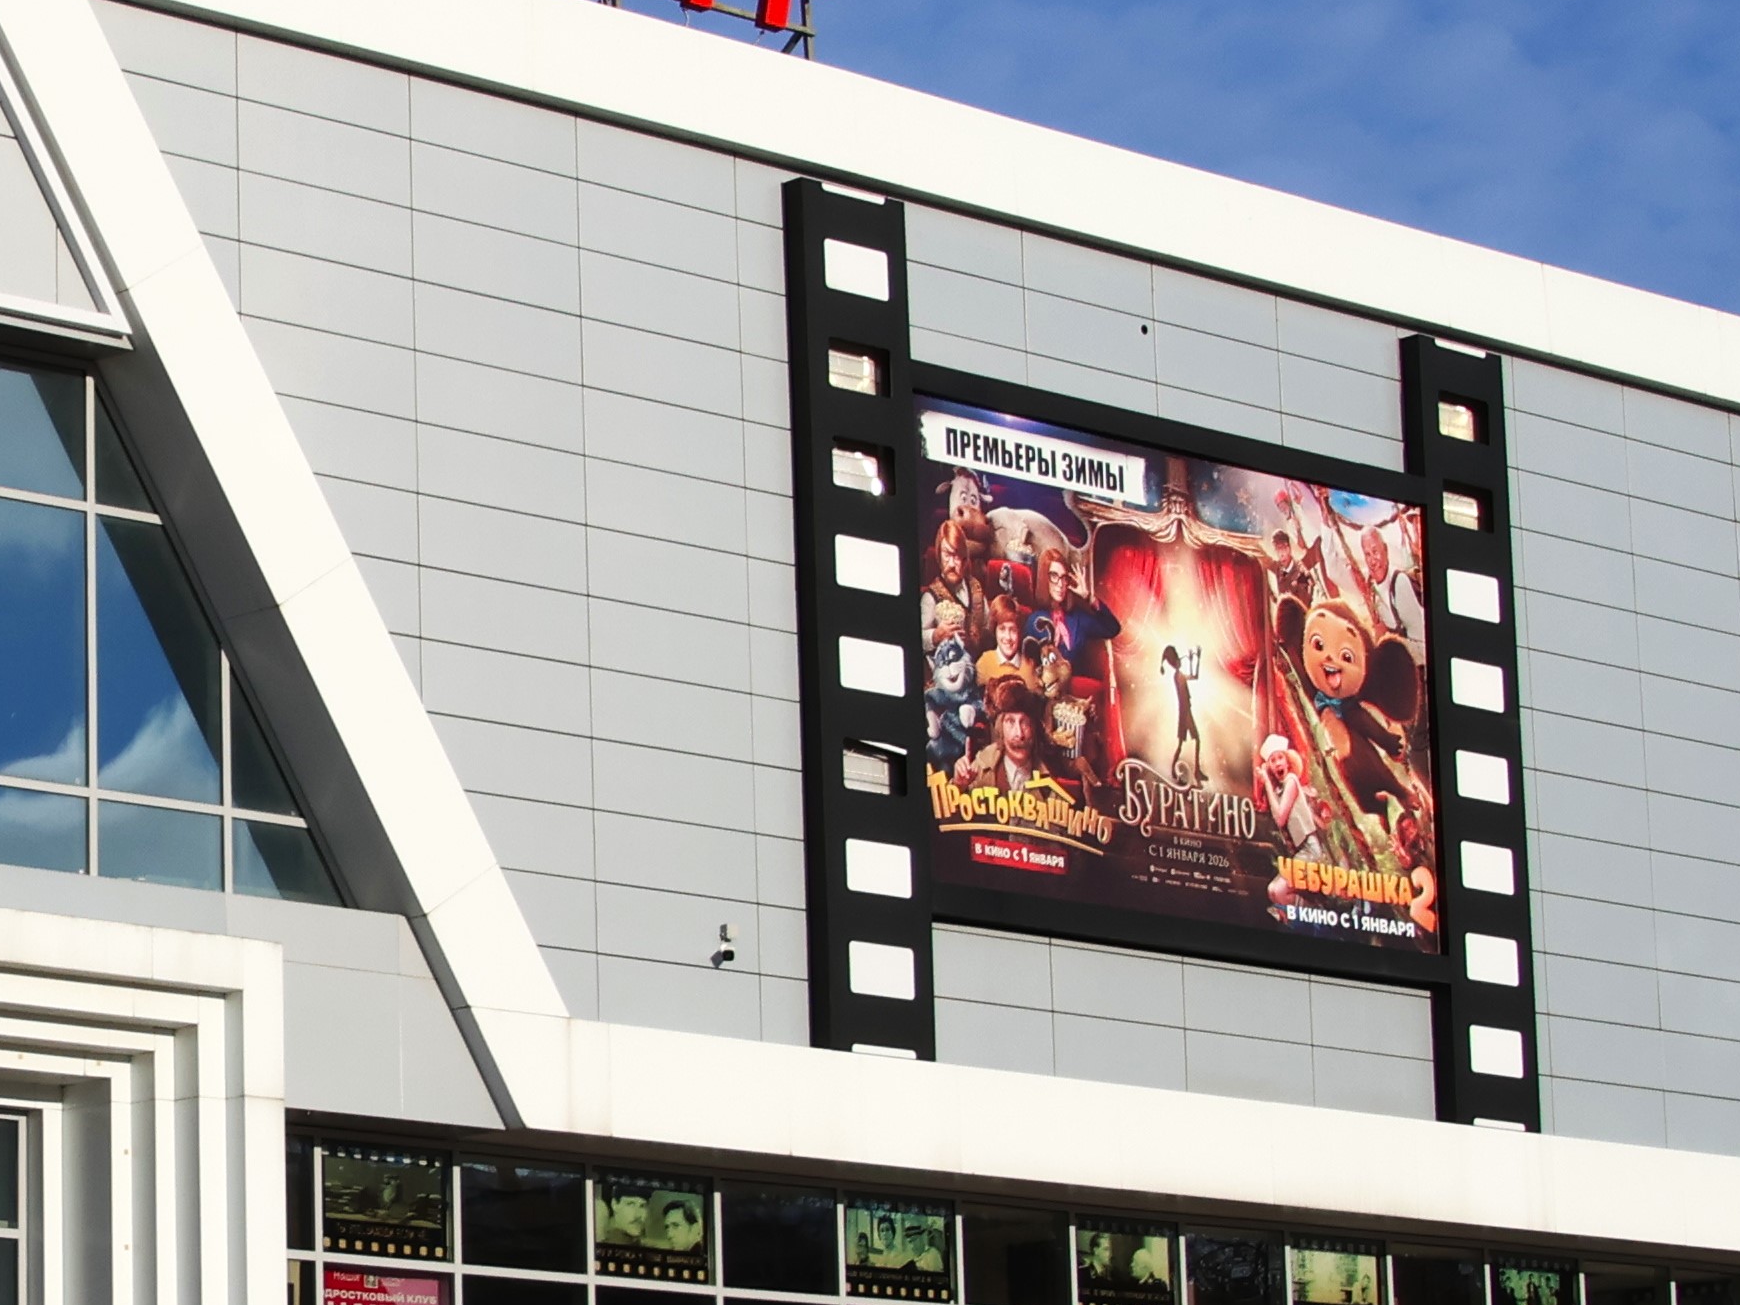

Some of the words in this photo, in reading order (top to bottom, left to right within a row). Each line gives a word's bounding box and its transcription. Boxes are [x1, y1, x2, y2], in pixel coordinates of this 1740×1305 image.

[945, 427, 1057, 479] ПРЕМЬЕРЫ
[1062, 452, 1124, 493] ЗИМЫ
[927, 762, 1113, 844] ПРОСТОКВАШИНО
[1116, 758, 1256, 838] БУРАТИНО
[975, 843, 982, 855] В
[985, 844, 1011, 859] КИНО
[1013, 849, 1020, 861] С
[1021, 847, 1028, 863] 1
[1028, 852, 1065, 868] ЯНВАРЯ
[1148, 844, 1157, 856] С
[1166, 847, 1206, 864] ЯНВАРЯ
[1208, 854, 1230, 868] 2026
[1180, 837, 1202, 848] КИНО
[1277, 855, 1413, 907] ЧЕБУРАШКА
[1409, 866, 1437, 933] 2
[1286, 905, 1296, 920] В
[1299, 908, 1338, 926] КИНО
[1340, 912, 1351, 928] С
[1352, 914, 1359, 930] 1
[1361, 916, 1416, 938] ЯНВАРЯ
[323, 1288, 405, 1304] ДРОСТКОВЫЙ
[407, 1294, 437, 1305] КЛУБ
